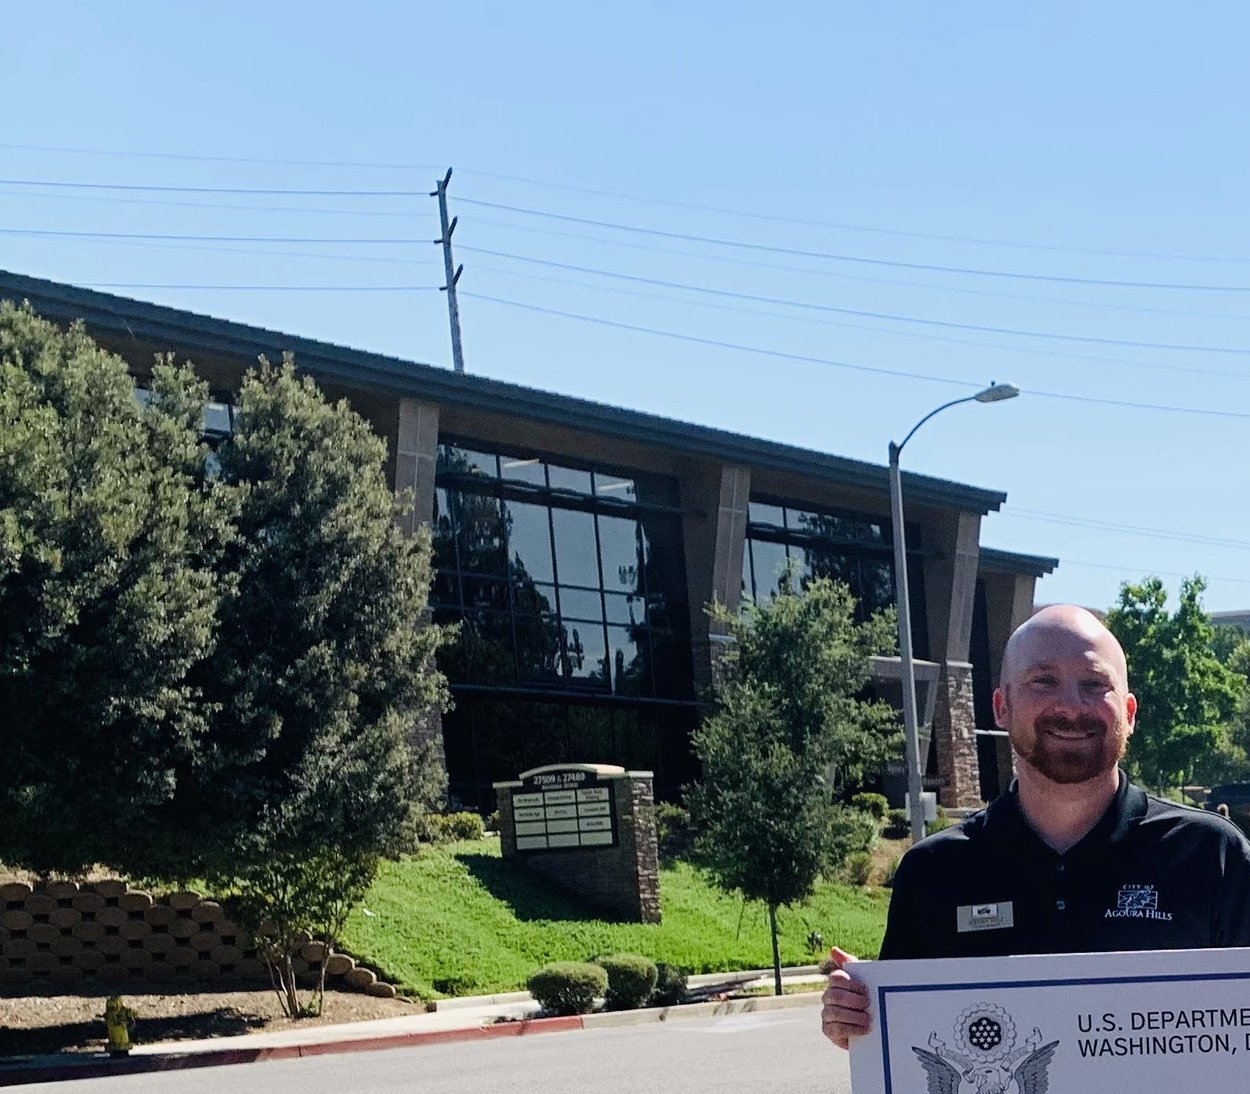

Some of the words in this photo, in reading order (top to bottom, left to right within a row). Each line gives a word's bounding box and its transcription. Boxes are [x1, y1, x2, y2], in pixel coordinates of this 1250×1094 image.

[1104, 908, 1144, 918] AGOURA
[1145, 909, 1173, 921] HILLS
[1077, 1012, 1123, 1033] U.S.
[1077, 1033, 1238, 1058] WASHINGTON,
